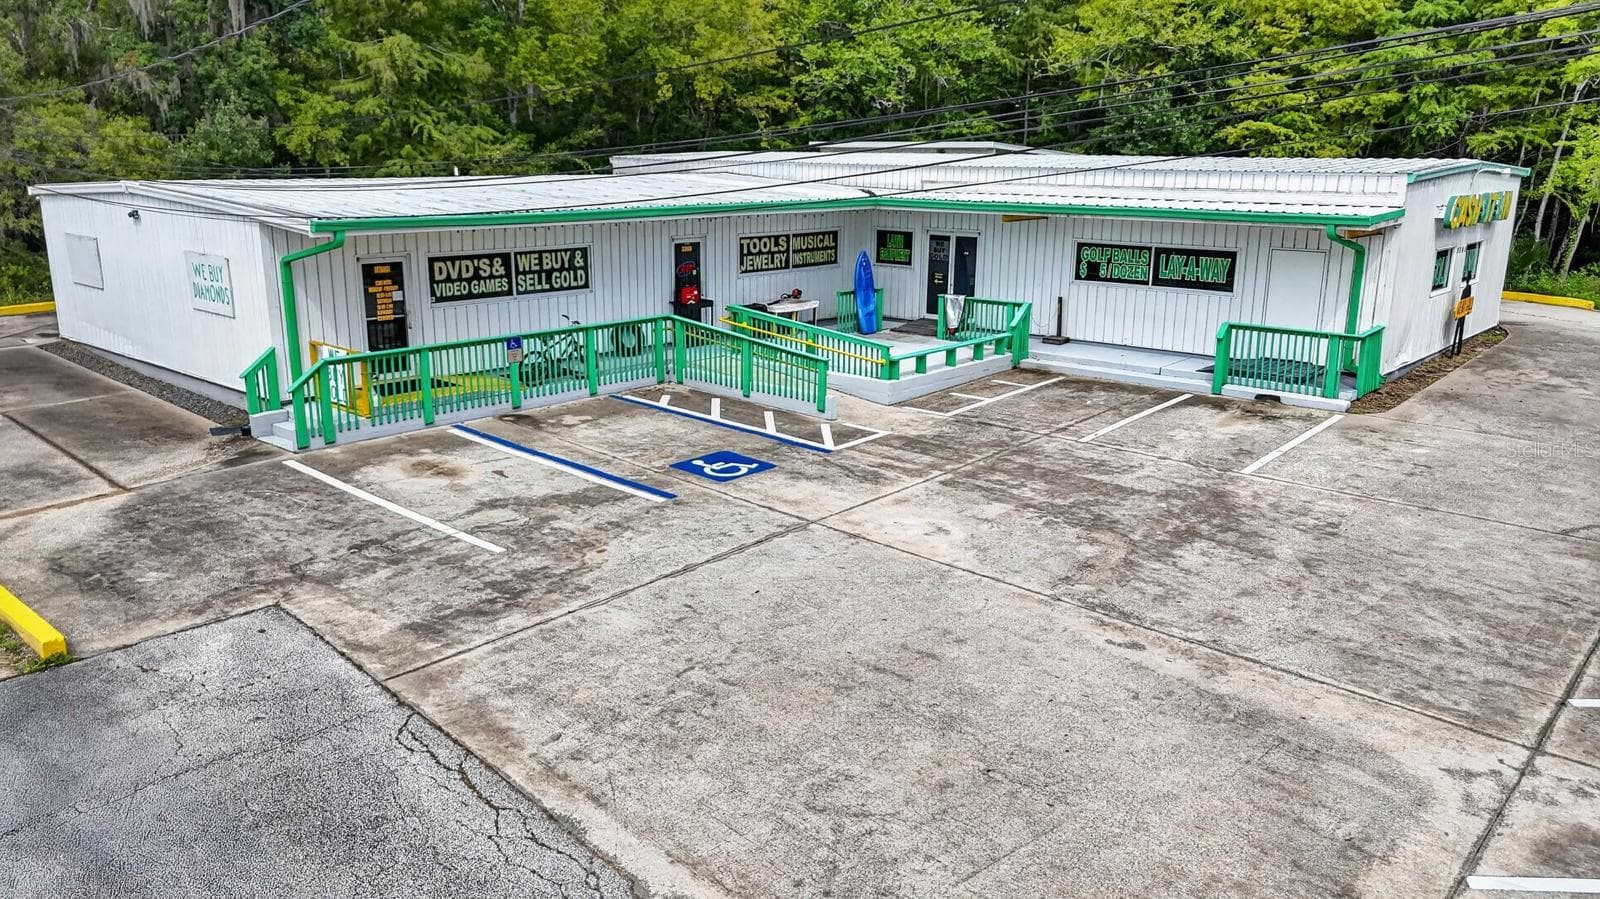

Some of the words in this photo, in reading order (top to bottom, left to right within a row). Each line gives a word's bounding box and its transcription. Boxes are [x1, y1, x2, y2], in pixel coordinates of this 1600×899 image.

[741, 236, 787, 254] TOOLS
[793, 234, 835, 250] MUSICAL
[517, 253, 540, 271] WE
[542, 251, 571, 269] BUY
[574, 250, 585, 267] &
[741, 253, 787, 272] JEWELRY
[793, 250, 835, 265] INSTRUMENTS
[1081, 247, 1111, 262] GOLF
[1112, 249, 1149, 265] BALLS
[192, 262, 206, 280] WE
[208, 264, 223, 283] BUY
[1079, 261, 1087, 278] $
[1159, 254, 1231, 283] LAY-A-WAY
[433, 281, 468, 297] VIDEO
[470, 278, 508, 294] GAMES
[517, 273, 549, 291] SELL
[552, 269, 585, 288] GOLD
[192, 281, 230, 305] DIAMONDS
